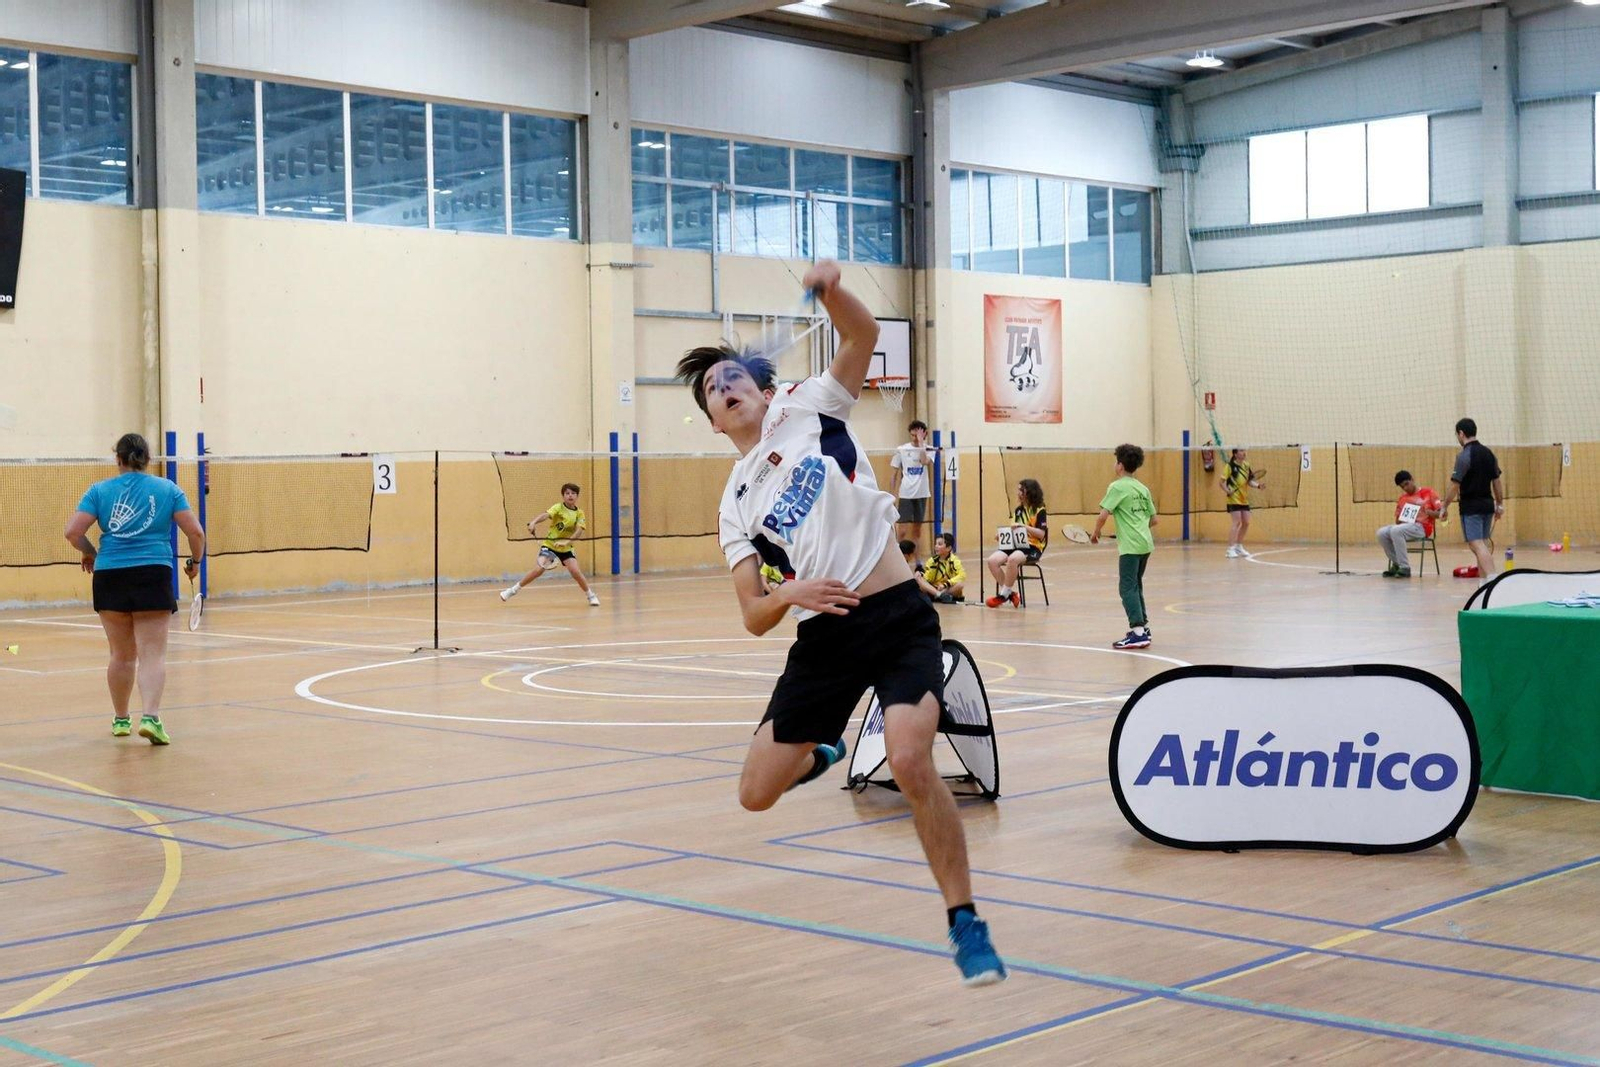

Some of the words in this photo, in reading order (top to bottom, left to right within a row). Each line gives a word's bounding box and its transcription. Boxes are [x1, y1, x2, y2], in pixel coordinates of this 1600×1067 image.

[1006, 325, 1042, 365] TEA
[948, 456, 957, 477] 4
[1303, 451, 1309, 469] 5
[1564, 450, 1570, 465] 6
[378, 464, 391, 490] 3
[999, 532, 1011, 545] 22
[1015, 532, 1026, 544] 12
[1133, 729, 1458, 792] Atlántico
